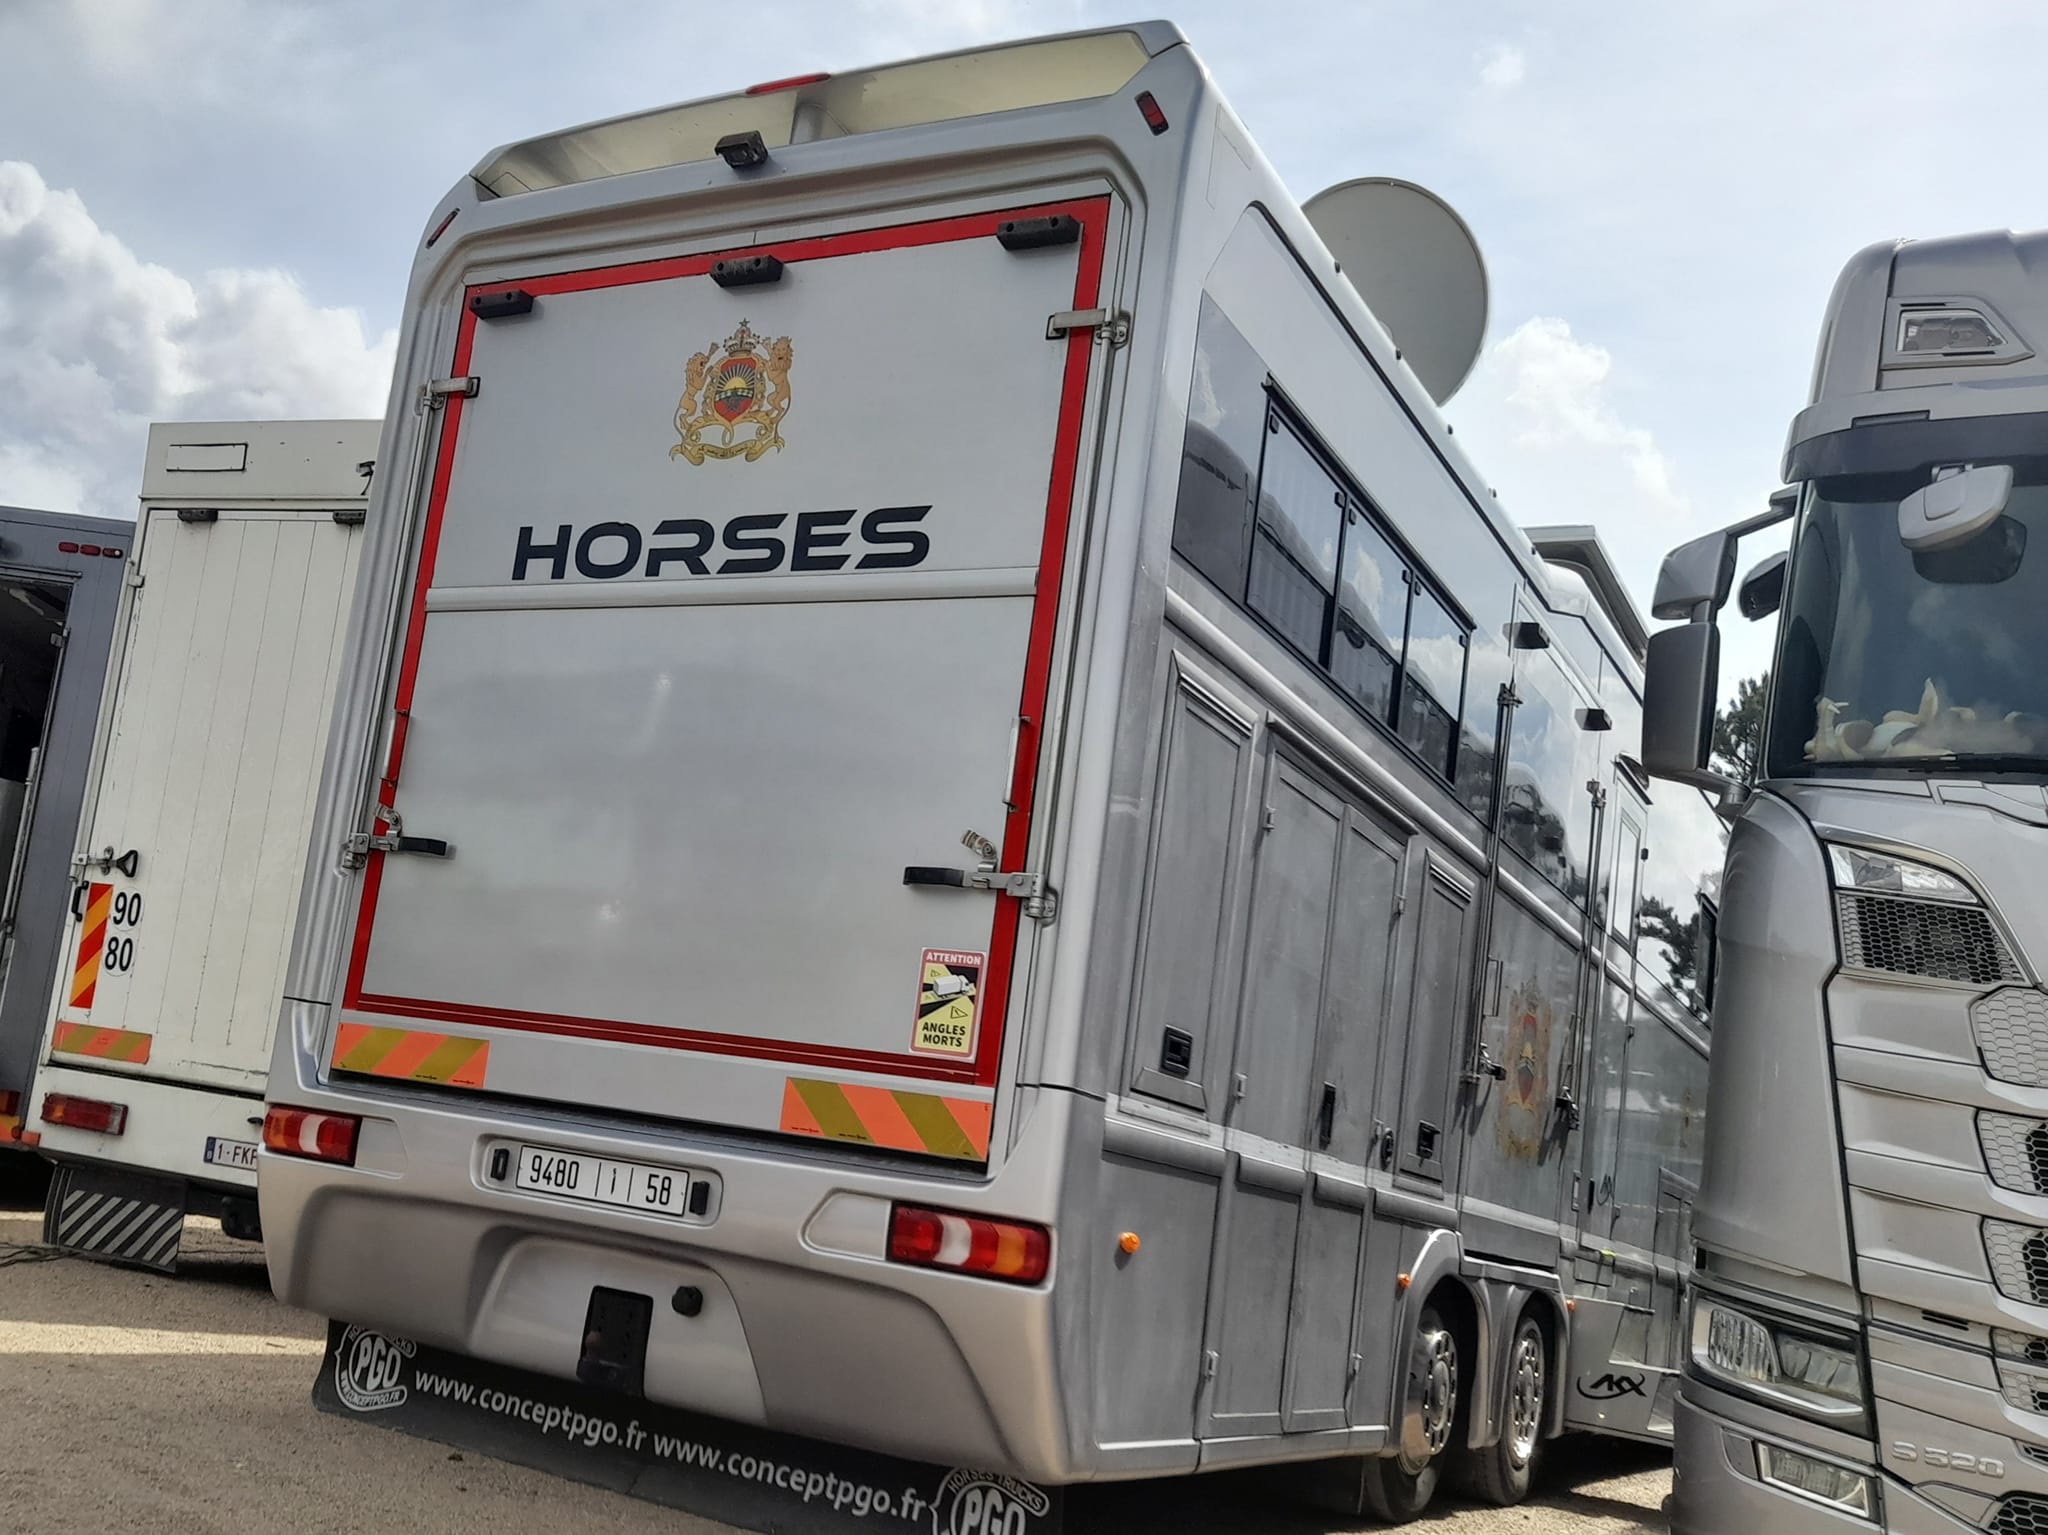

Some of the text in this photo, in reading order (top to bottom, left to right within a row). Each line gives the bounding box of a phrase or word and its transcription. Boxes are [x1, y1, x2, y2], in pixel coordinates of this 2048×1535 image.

[512, 505, 933, 580] HORSES
[113, 892, 142, 927] 90
[105, 936, 133, 972] 80
[926, 951, 981, 966] ATTENTION
[922, 1021, 966, 1036] ANGLES
[923, 1033, 962, 1047] MORTS
[529, 1155, 580, 1189] 9480
[645, 1174, 672, 1205] 58
[354, 1336, 402, 1391] PGO
[415, 1370, 927, 1521] www.conceptpgo.fr www.conceptpgo.fr
[1892, 1441, 2005, 1479] S 520
